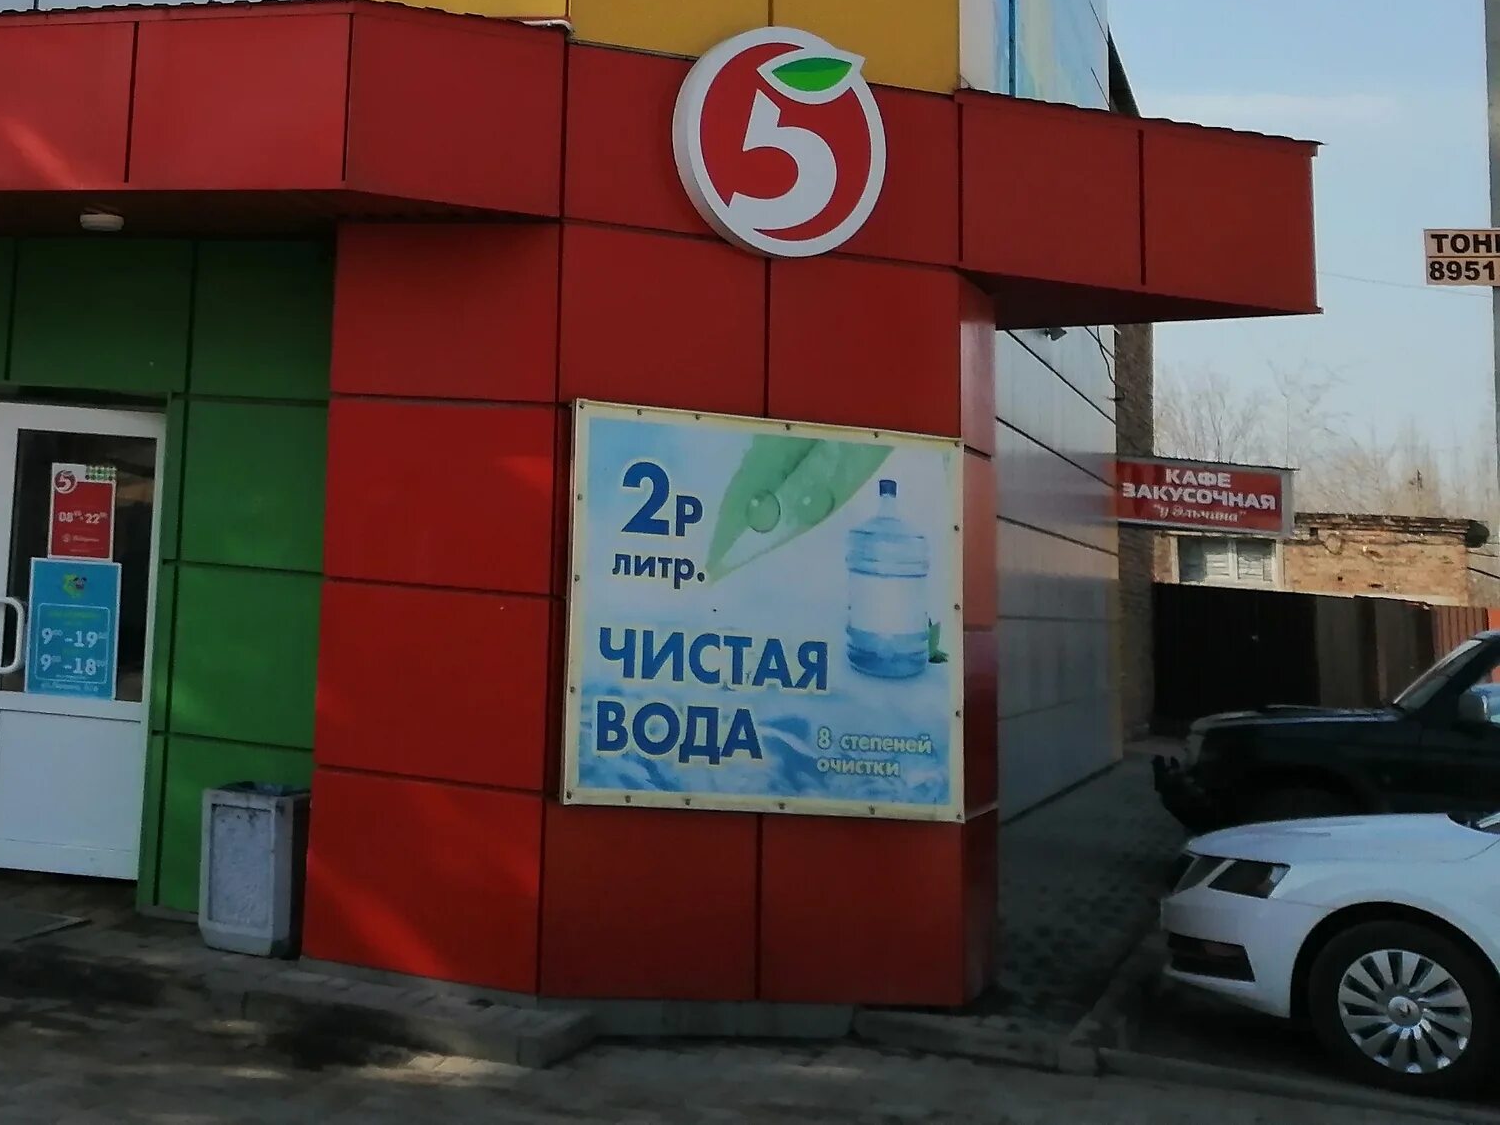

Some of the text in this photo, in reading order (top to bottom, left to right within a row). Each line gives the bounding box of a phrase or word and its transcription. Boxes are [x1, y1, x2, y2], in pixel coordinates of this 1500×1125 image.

[1430, 233, 1500, 254] ТОН
[1165, 468, 1232, 488] КАФЕ
[1122, 483, 1276, 510] ЗАКУСОЧНАЯ
[611, 553, 706, 590] литр.
[599, 627, 828, 691] ЧИСТАЯ
[596, 700, 763, 765] ВОДА
[817, 727, 933, 755] 8 степеней
[816, 757, 901, 777] очистки
